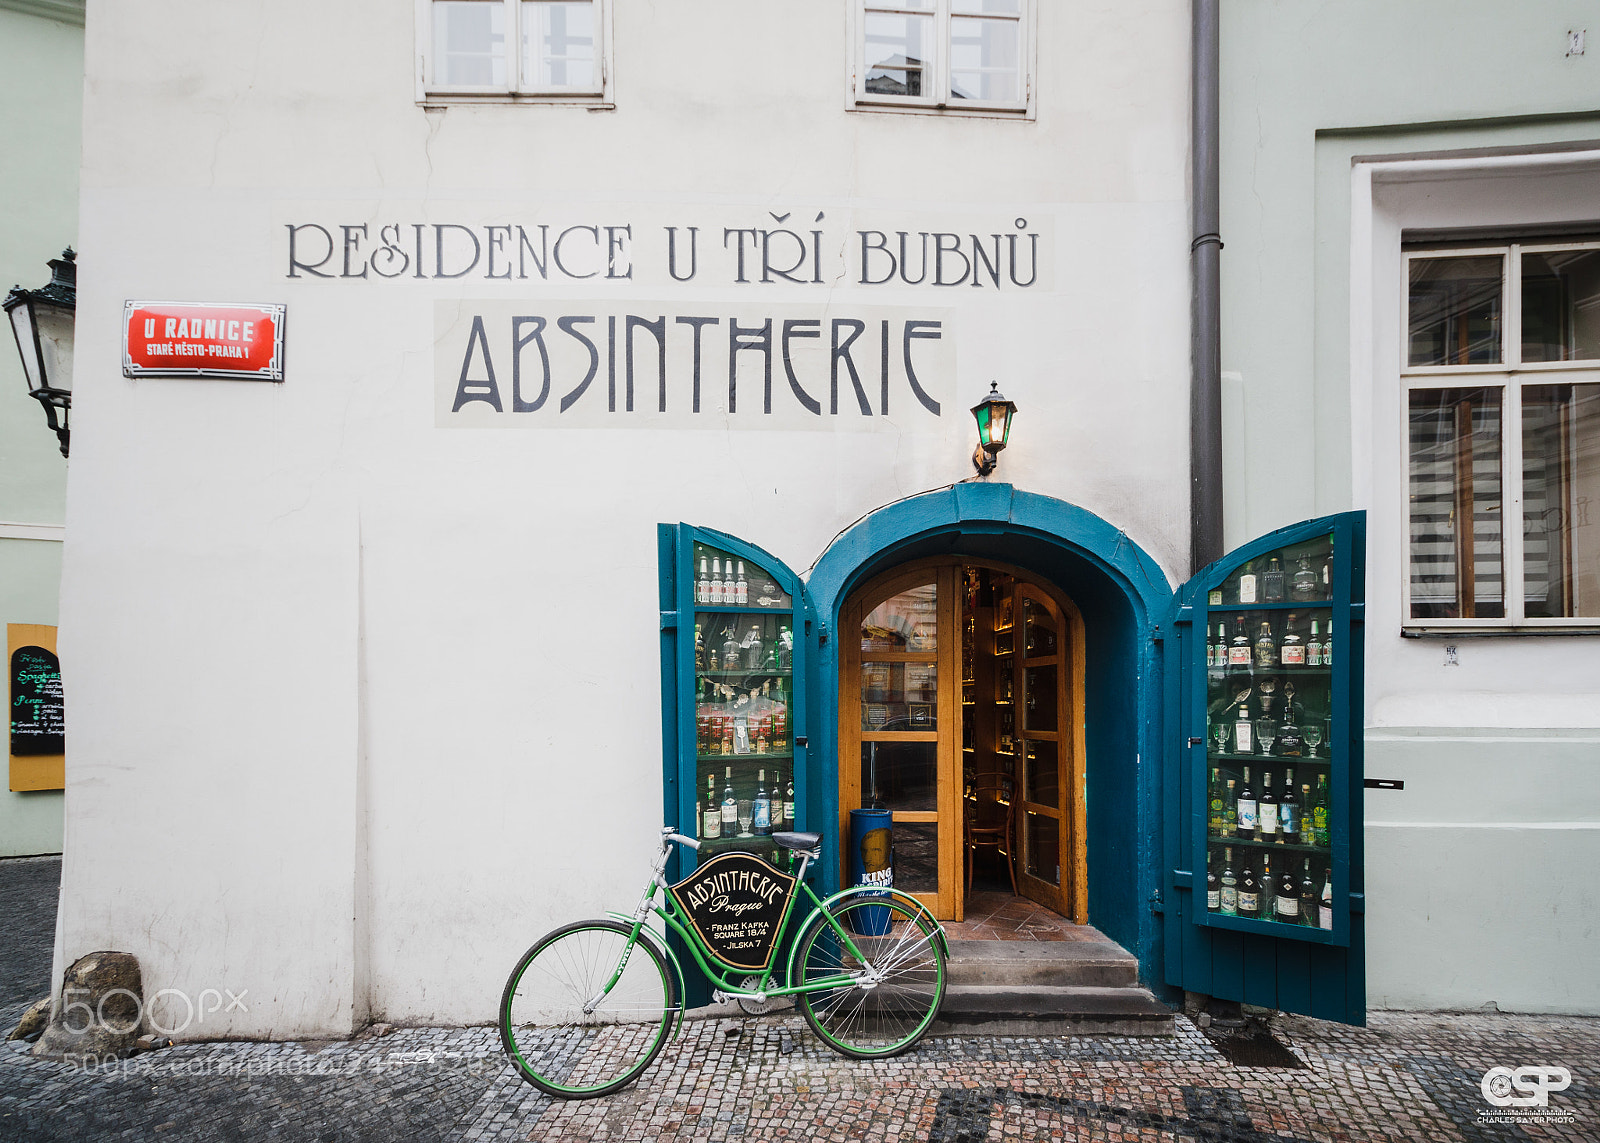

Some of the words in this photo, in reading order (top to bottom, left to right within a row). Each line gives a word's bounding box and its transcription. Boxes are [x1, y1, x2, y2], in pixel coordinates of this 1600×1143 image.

[285, 221, 634, 280] RESIDENCE
[664, 224, 700, 281] U
[723, 211, 824, 285] TŘÍ
[857, 217, 1041, 290] BUBNŮ
[144, 318, 155, 339] U
[165, 318, 254, 342] RADNICE
[146, 341, 173, 356] STARÉ
[243, 347, 249, 359] 1
[451, 314, 943, 417] ABSINTHERIE
[861, 867, 892, 884] KING
[687, 870, 783, 910] ABSINTHERIE
[709, 894, 764, 917] Prague
[711, 923, 739, 932] FRANZ
[741, 921, 770, 930] KAFKA
[713, 931, 745, 939] SQUARE
[747, 928, 767, 936] 18/4
[755, 939, 761, 948] 7
